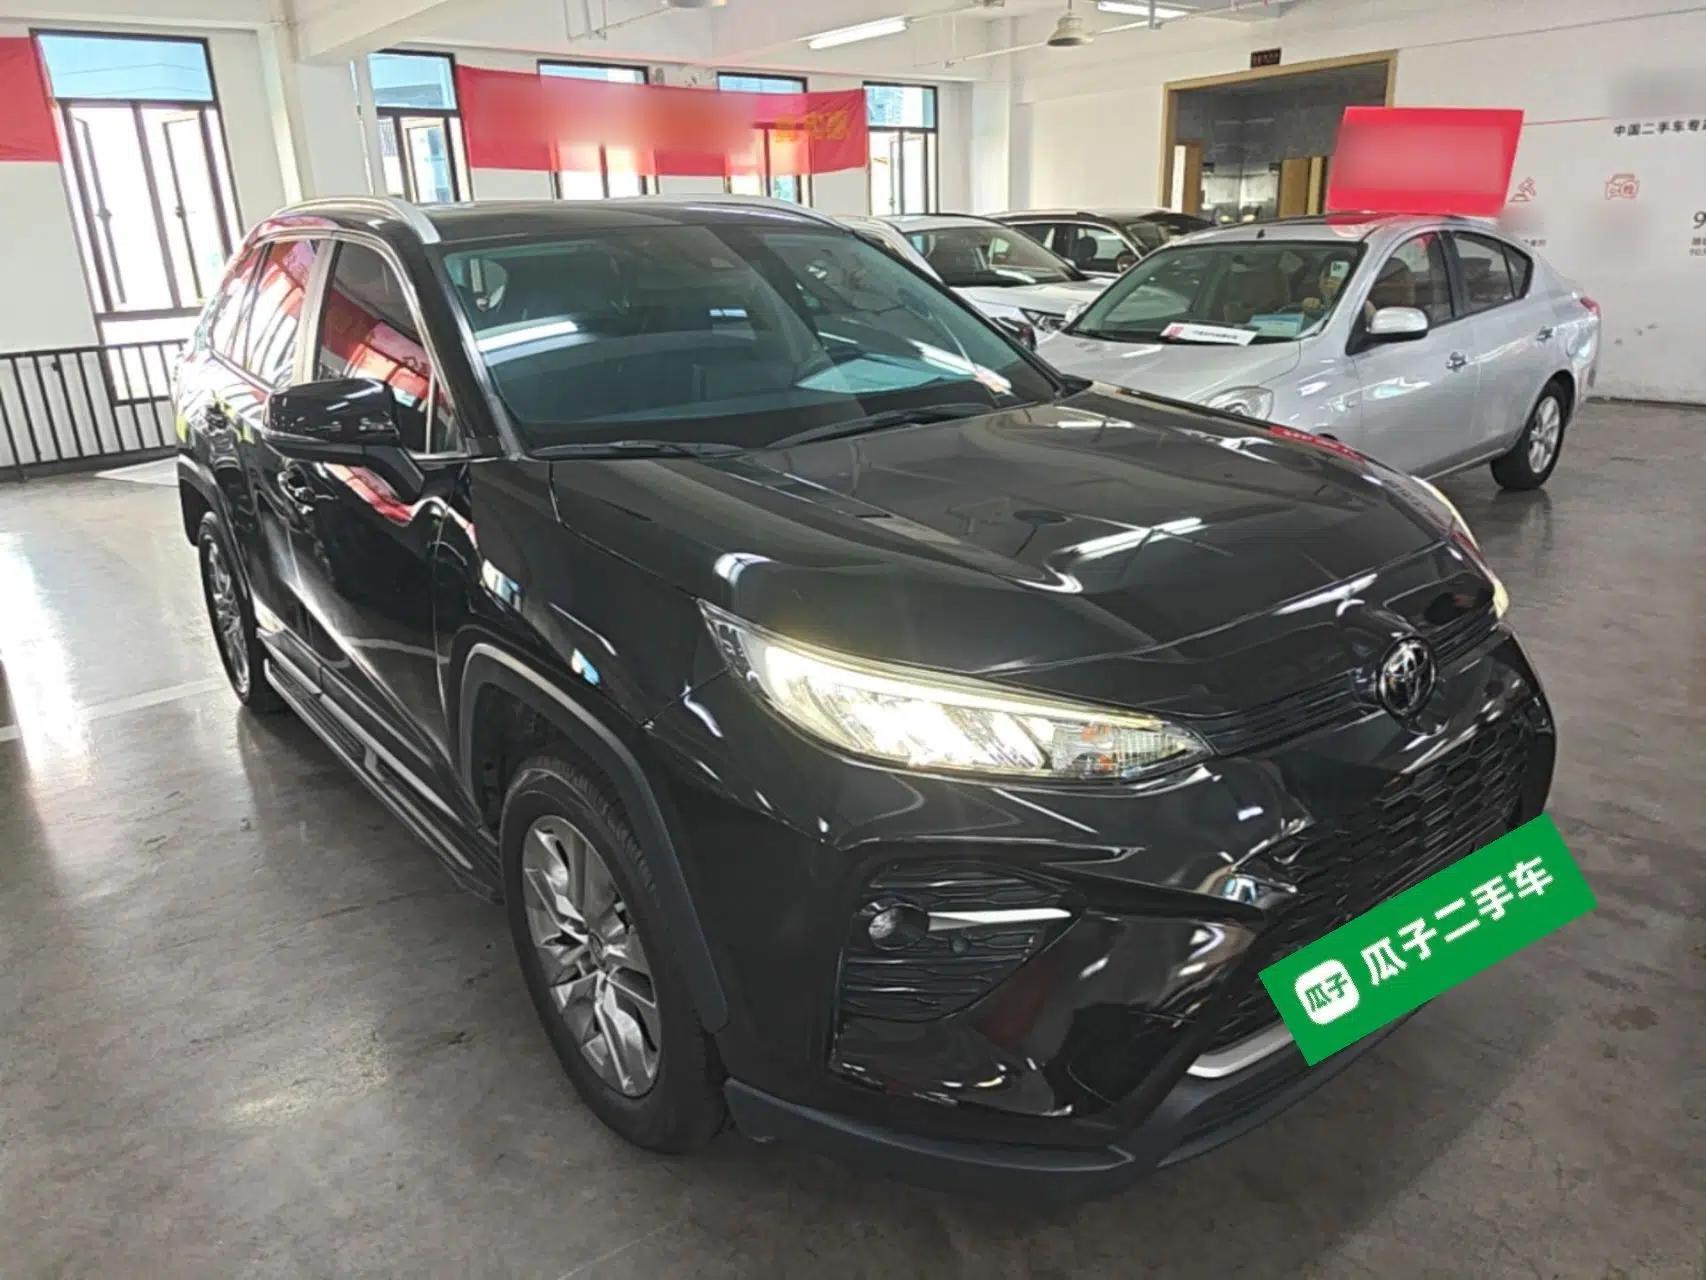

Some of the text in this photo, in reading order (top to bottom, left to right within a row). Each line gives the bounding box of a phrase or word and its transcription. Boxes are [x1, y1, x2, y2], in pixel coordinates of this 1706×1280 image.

[1614, 119, 1706, 136] 中国二手车
